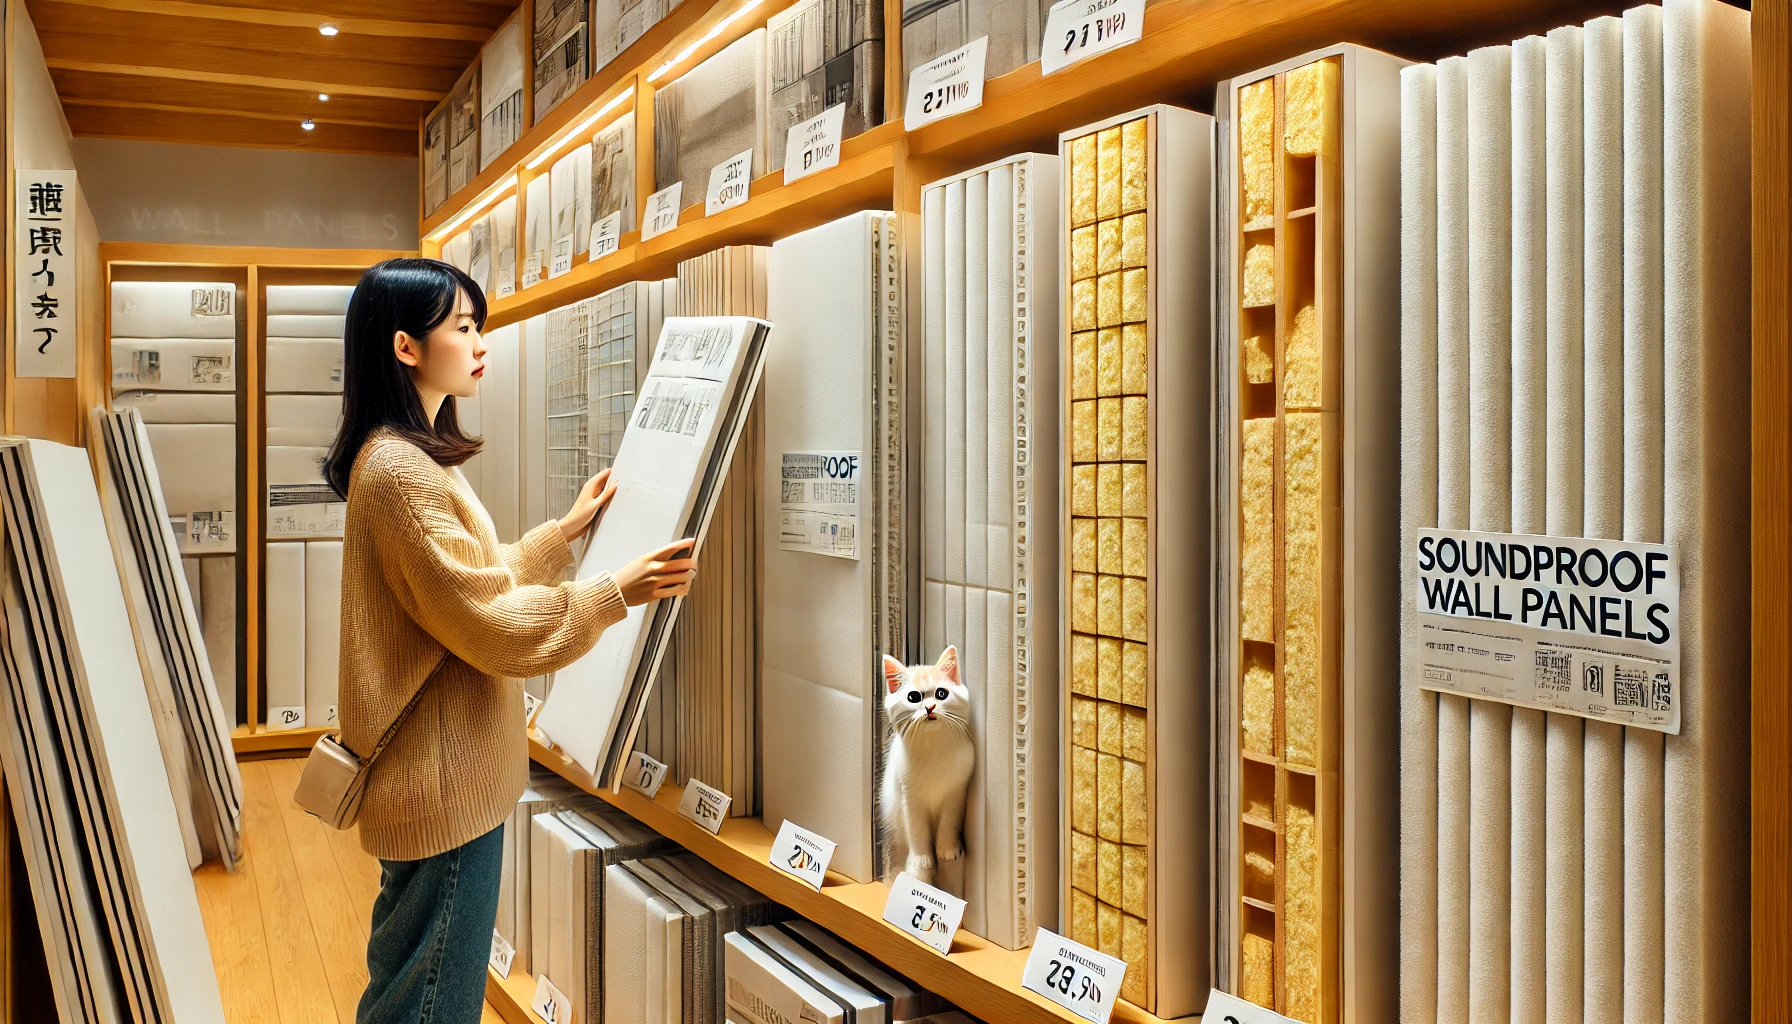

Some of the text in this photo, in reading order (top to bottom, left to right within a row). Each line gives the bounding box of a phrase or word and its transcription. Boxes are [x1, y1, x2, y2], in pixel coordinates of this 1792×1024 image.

[130, 208, 399, 241] WALL PANELS
[1419, 536, 1669, 594] SOUNDPROOF
[1421, 577, 1670, 644] WALL PANELS
